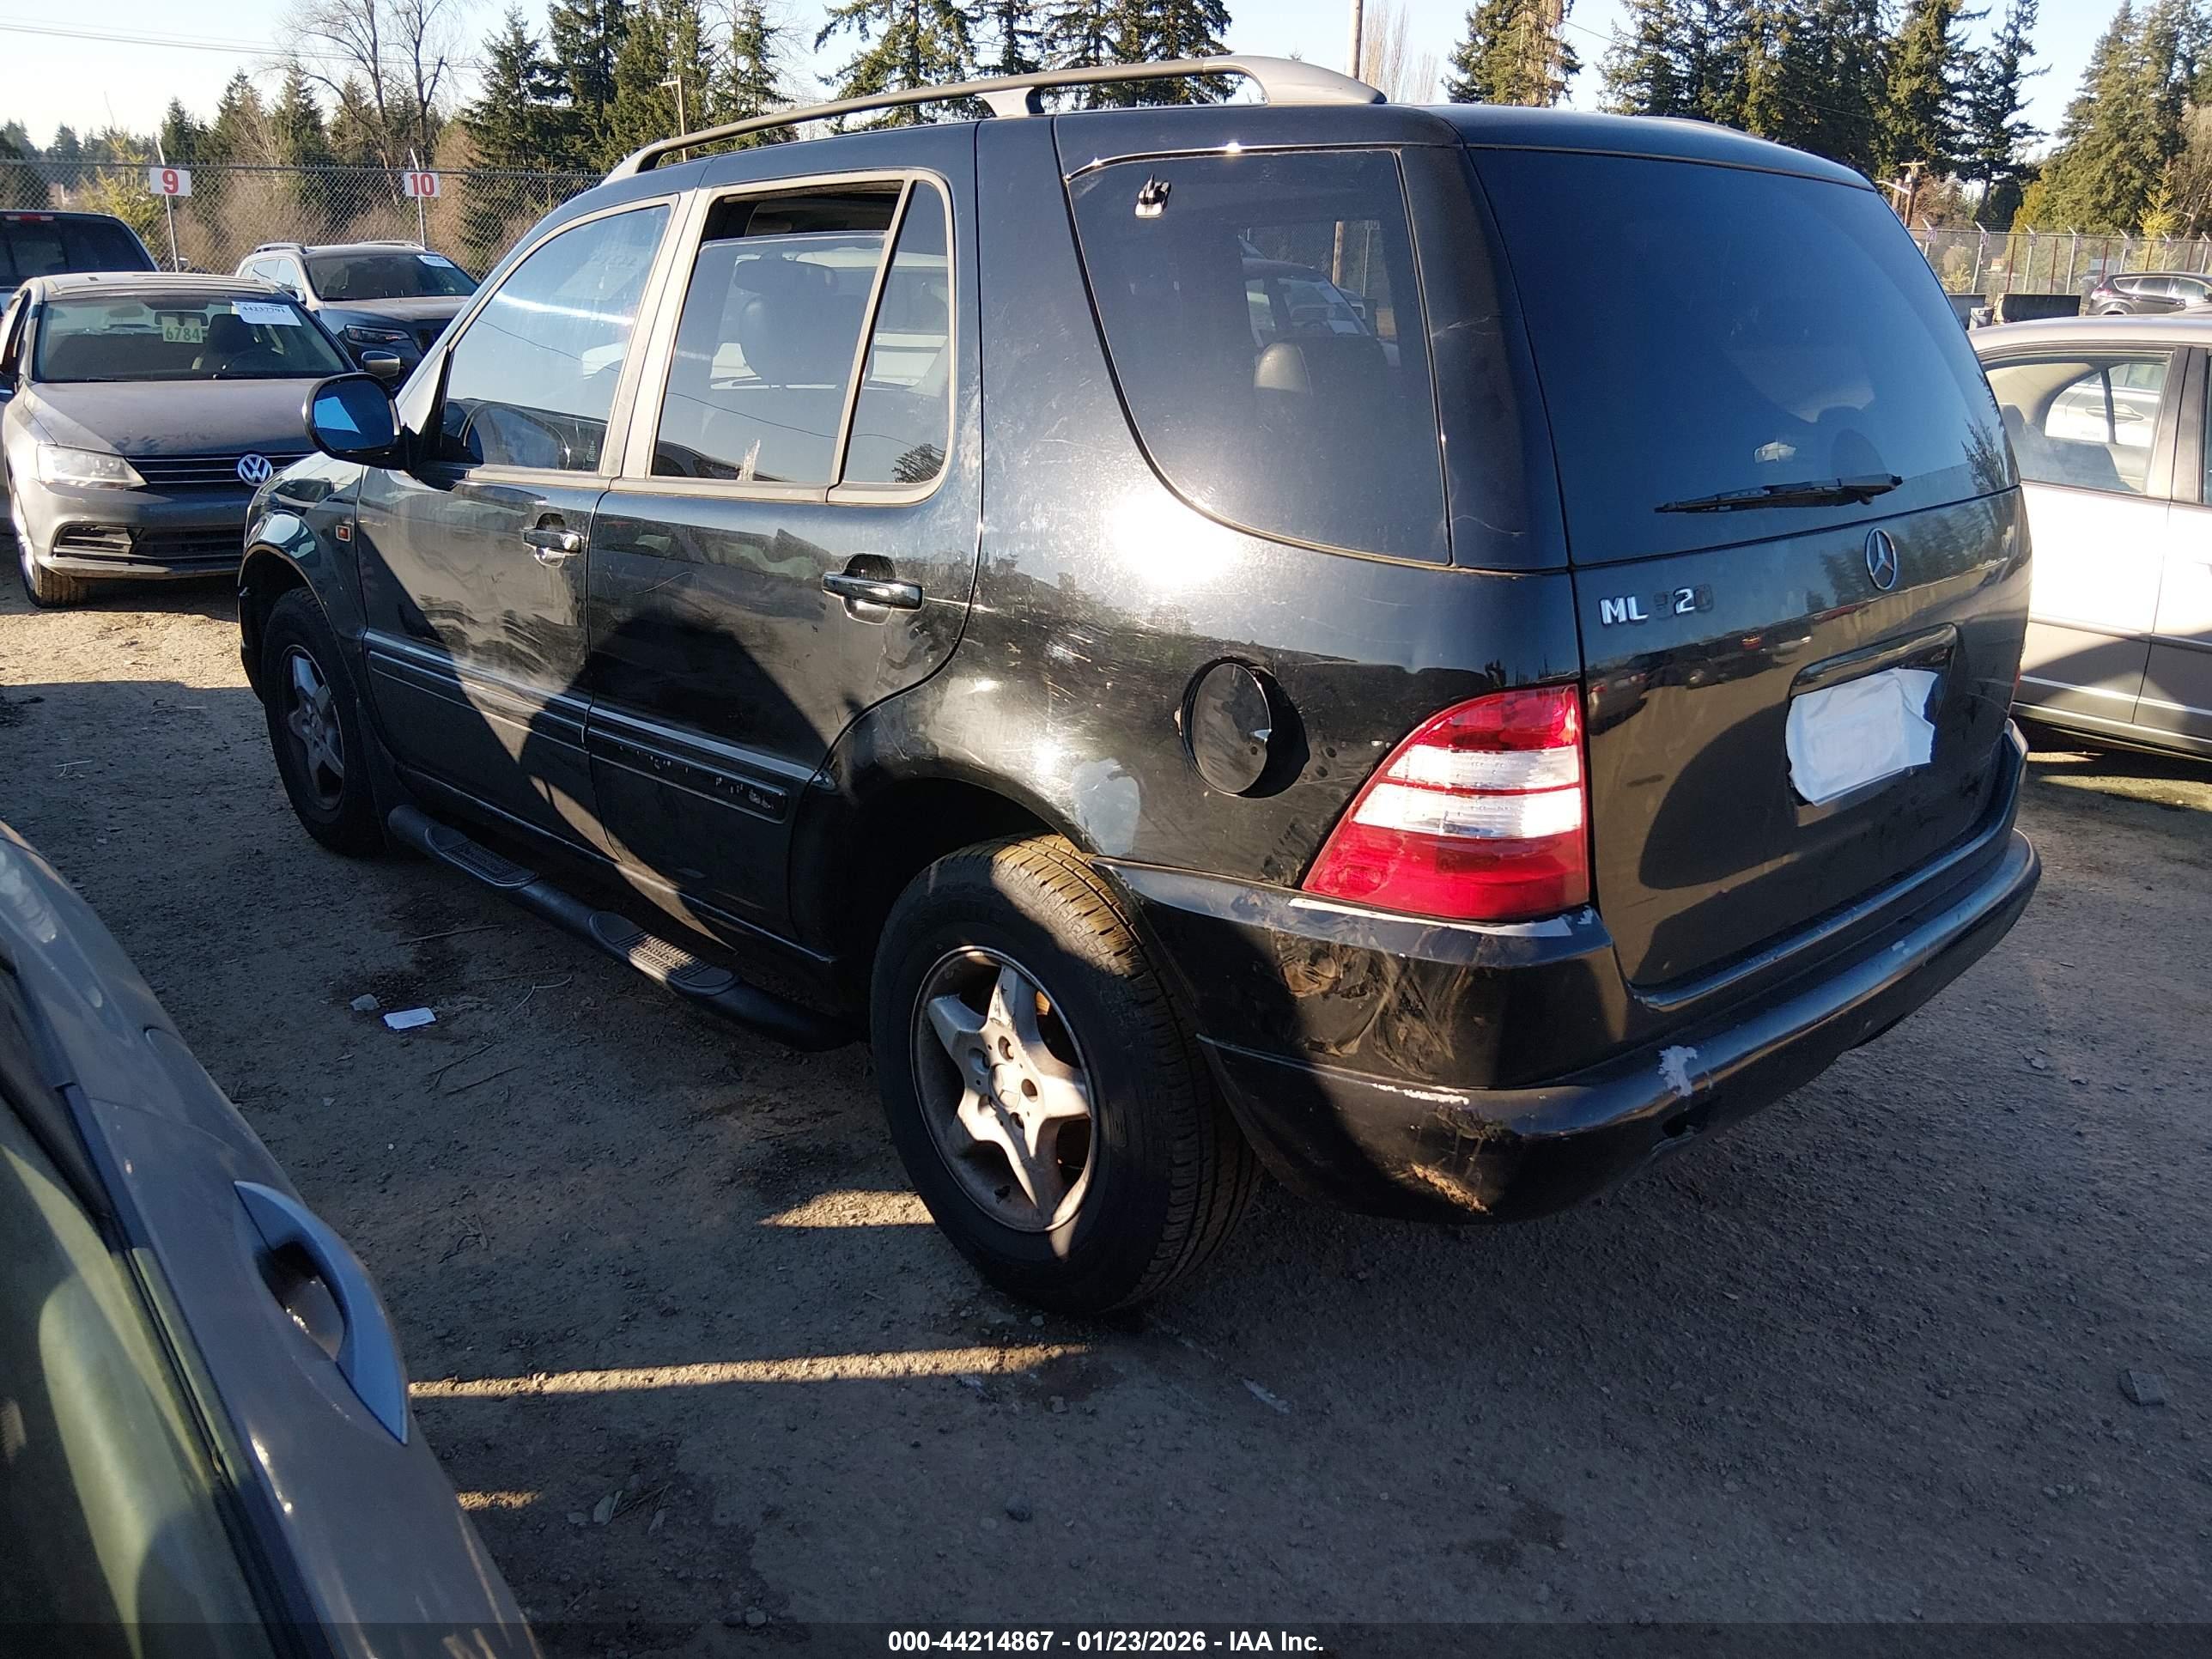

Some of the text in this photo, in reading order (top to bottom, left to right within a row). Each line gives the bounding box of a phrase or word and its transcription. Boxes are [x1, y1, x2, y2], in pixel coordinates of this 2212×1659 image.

[162, 169, 179, 194] 9
[410, 173, 434, 196] 10
[165, 326, 201, 342] 6784
[1600, 596, 1650, 625] ML
